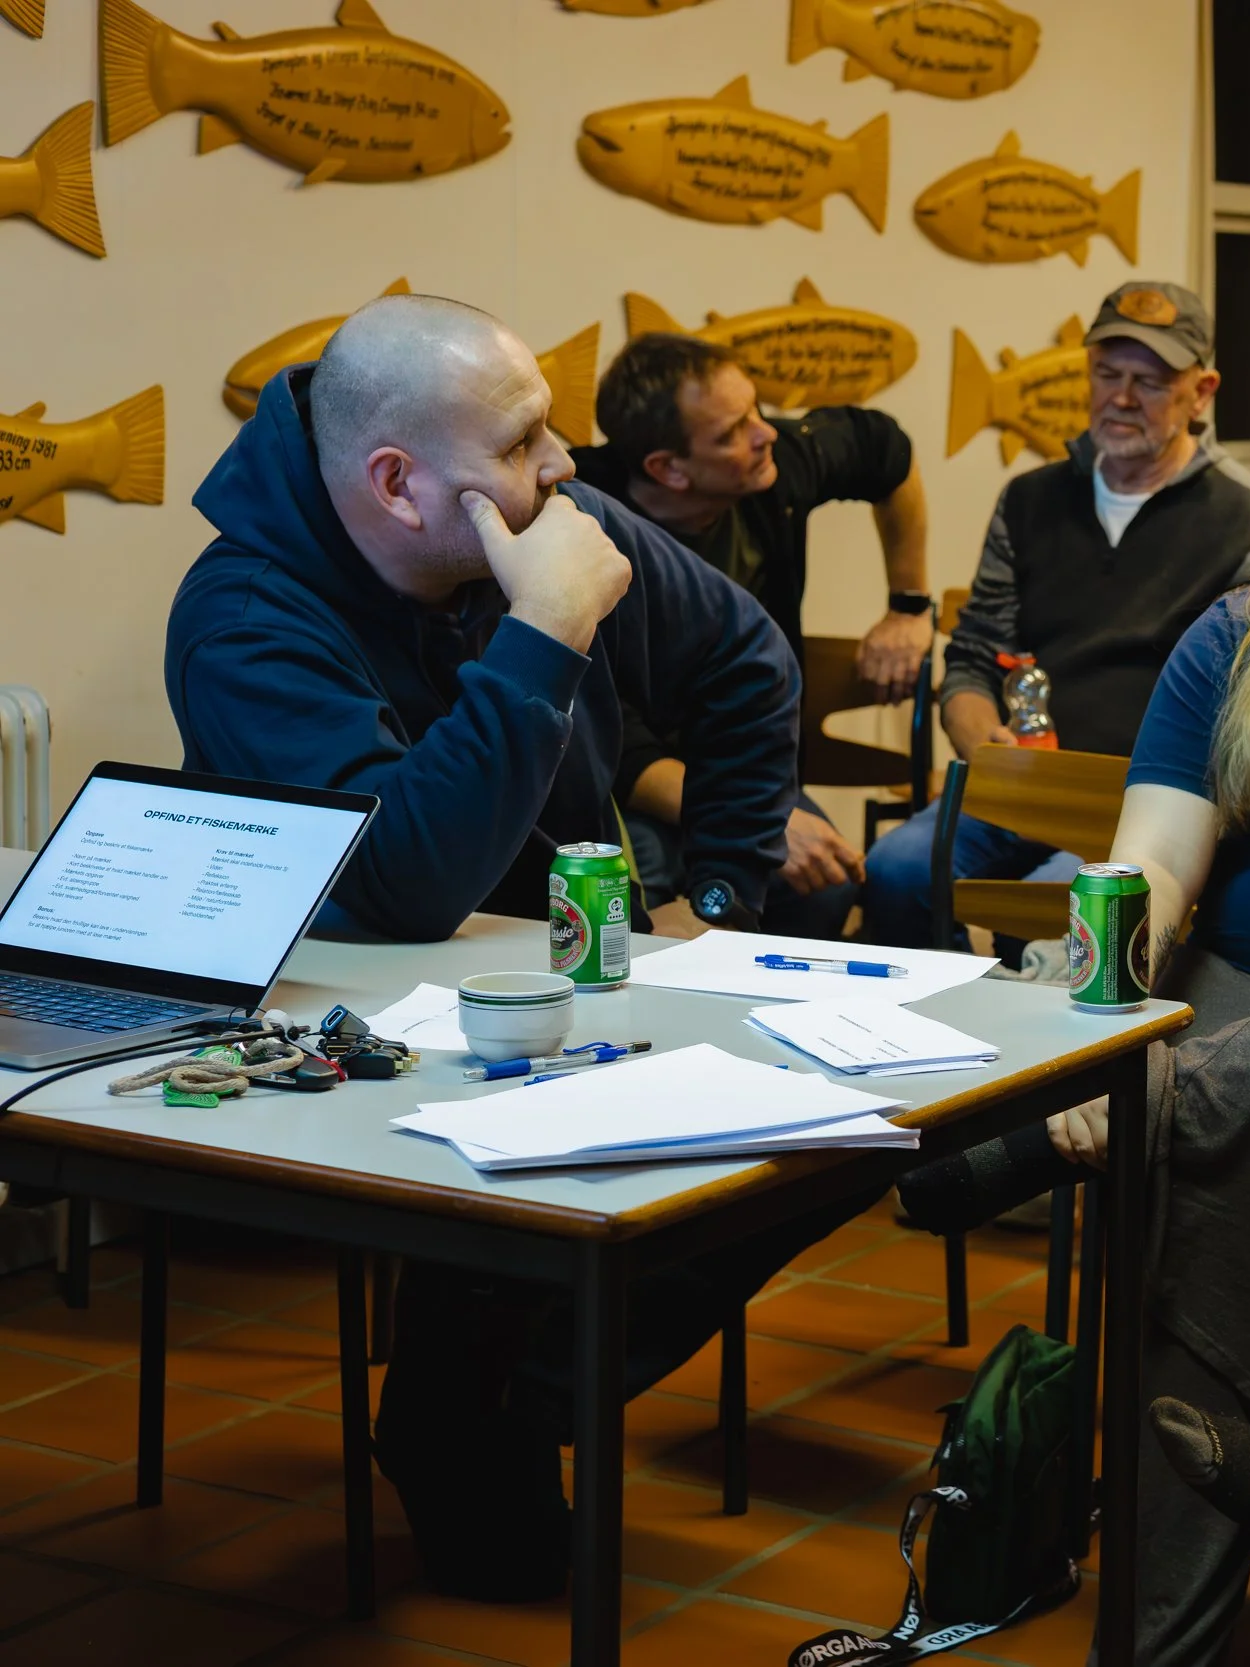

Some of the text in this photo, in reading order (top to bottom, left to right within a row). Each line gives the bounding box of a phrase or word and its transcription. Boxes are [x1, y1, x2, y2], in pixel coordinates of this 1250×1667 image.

[0, 430, 58, 461] ening 1981
[85, 829, 105, 838] Opgave
[143, 809, 279, 836] OPFIND ET FISKEMÆRKE
[233, 851, 255, 859] mærket
[794, 1635, 891, 1667] ØRGAARD
